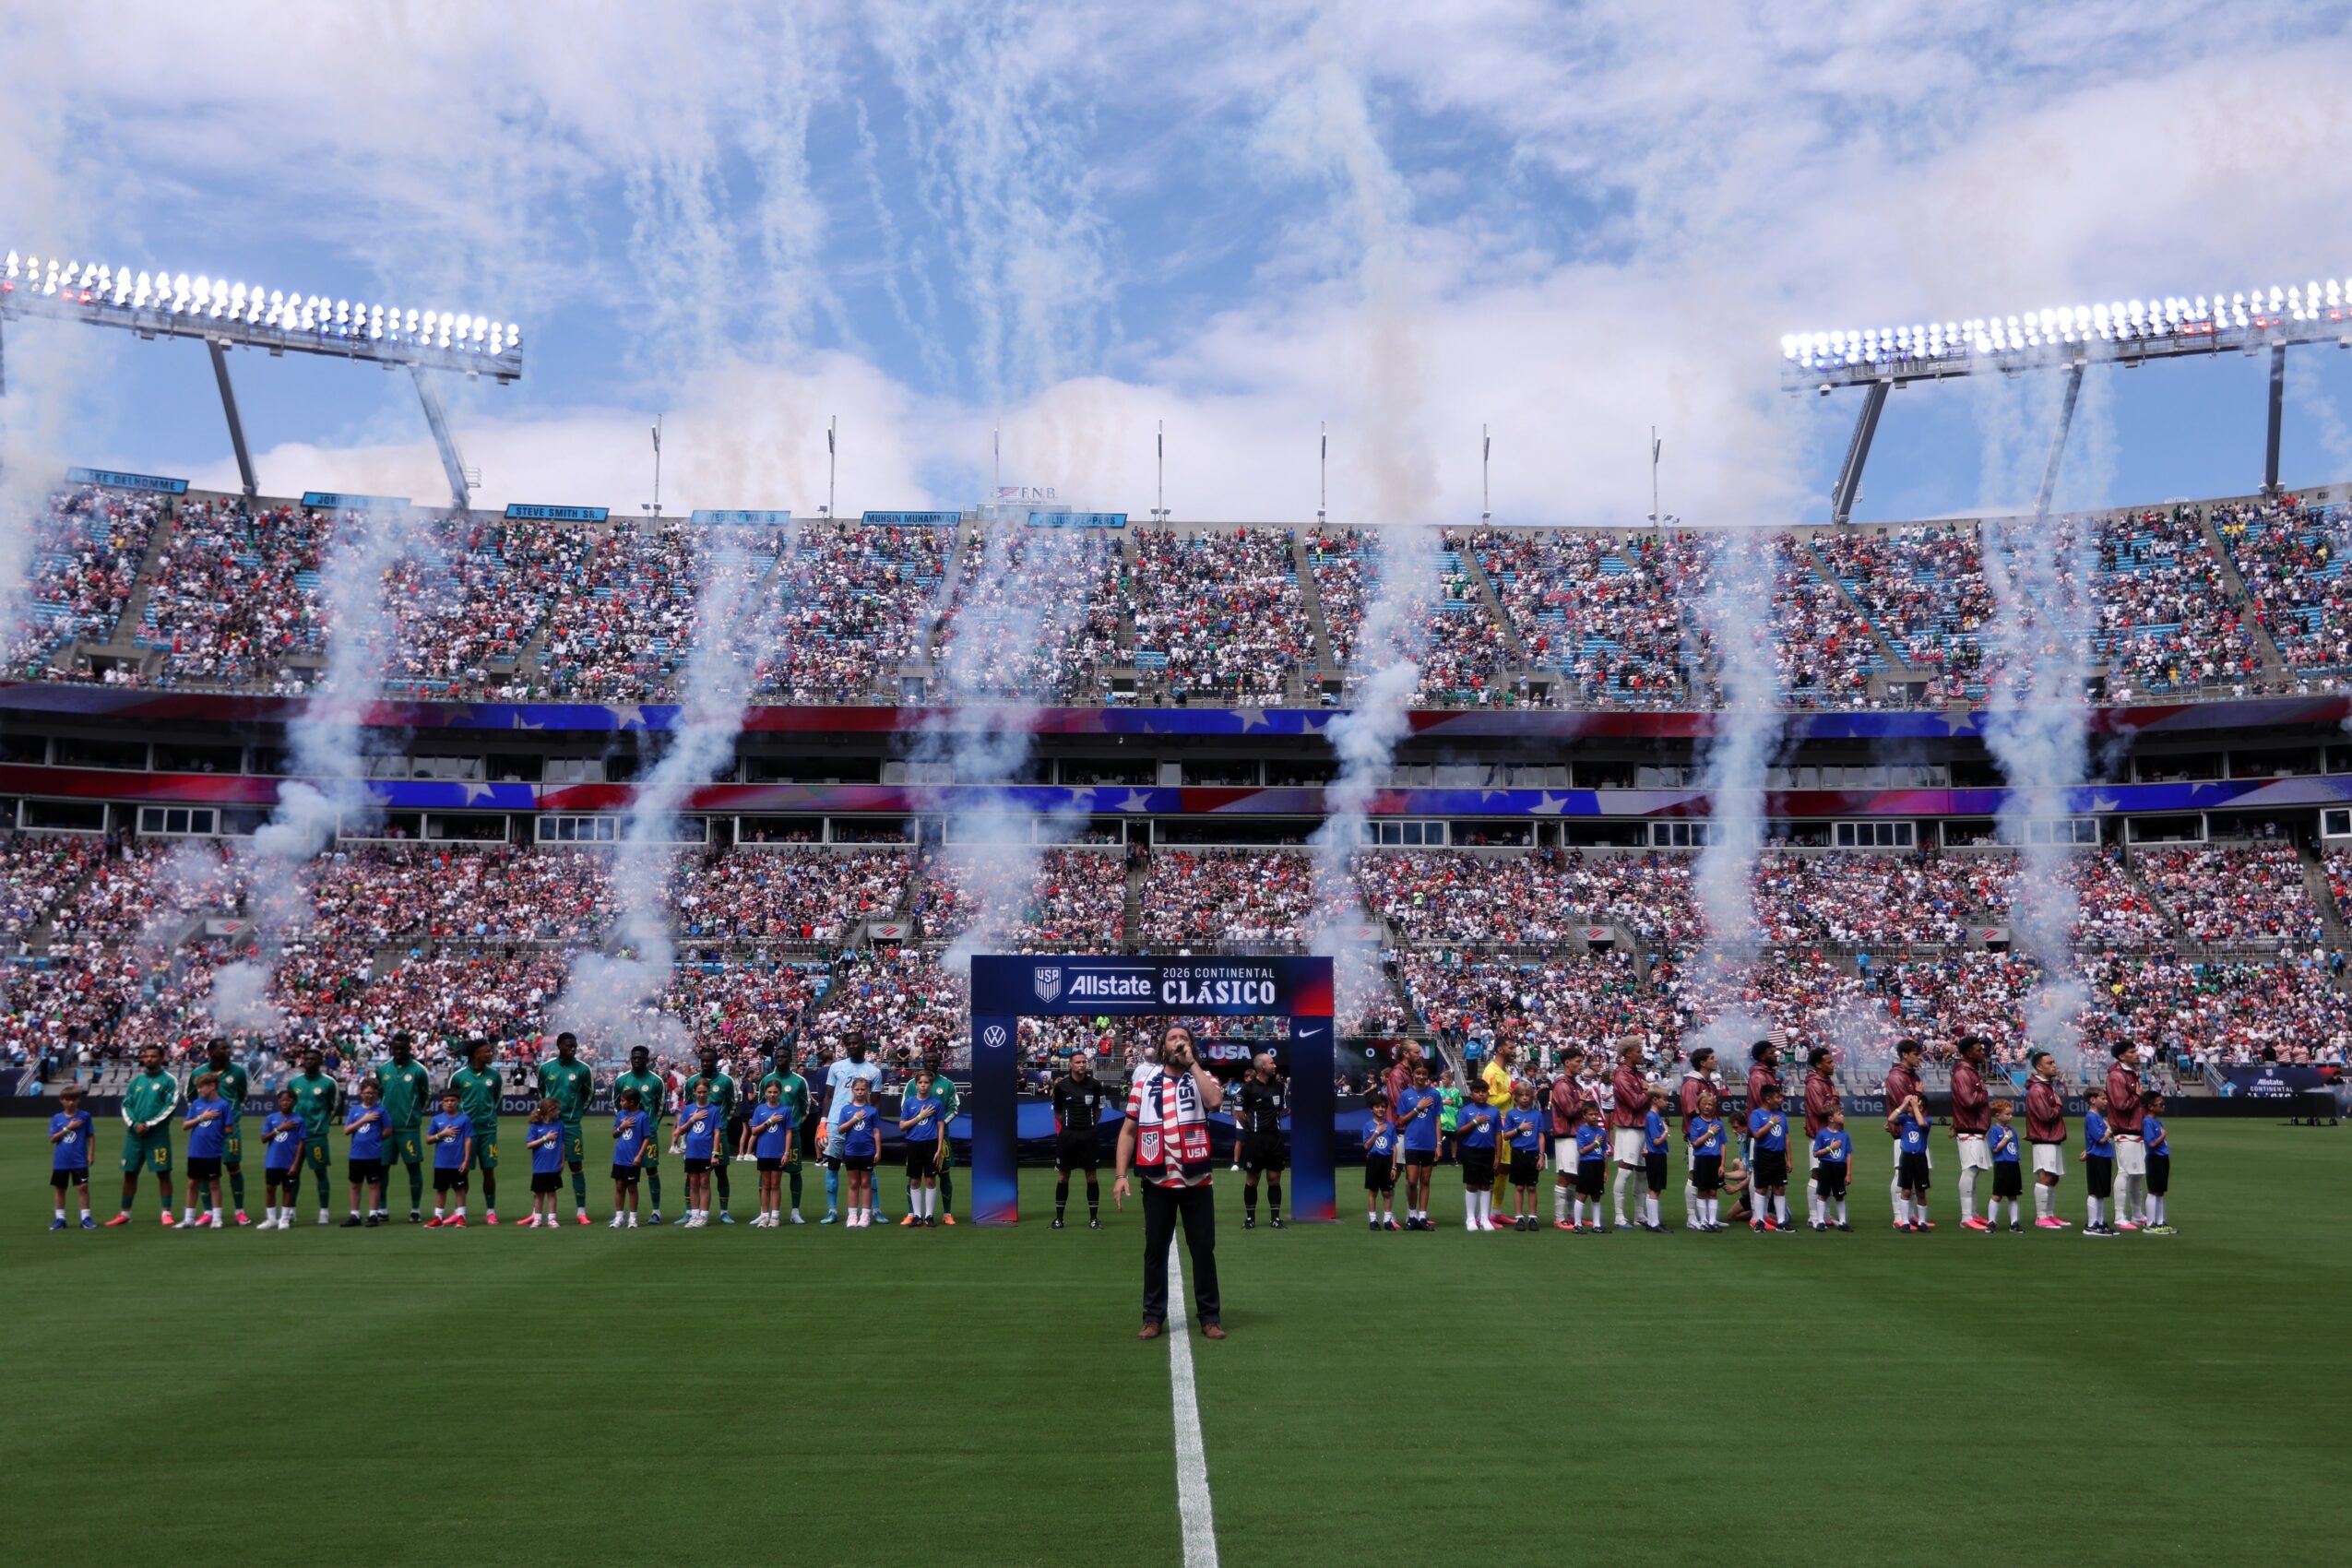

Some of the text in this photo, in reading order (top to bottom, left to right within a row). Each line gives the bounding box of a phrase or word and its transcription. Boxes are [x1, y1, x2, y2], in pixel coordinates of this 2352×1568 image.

[517, 506, 599, 519] STEVE SMITH SR.
[867, 514, 956, 524] MUHSIN MUHAMMAD
[1037, 970, 1059, 983] USA
[1162, 968, 1276, 979] 2026 CONTINENTAL
[1068, 975, 1151, 995] Allstate
[1162, 980, 1276, 1004] CLÁSICO
[1208, 1045, 1252, 1060] USA
[1851, 1099, 1883, 1112] the
[574, 1138, 580, 1152] 2
[1142, 1133, 1158, 1146] USA
[1186, 1146, 1208, 1158] USA
